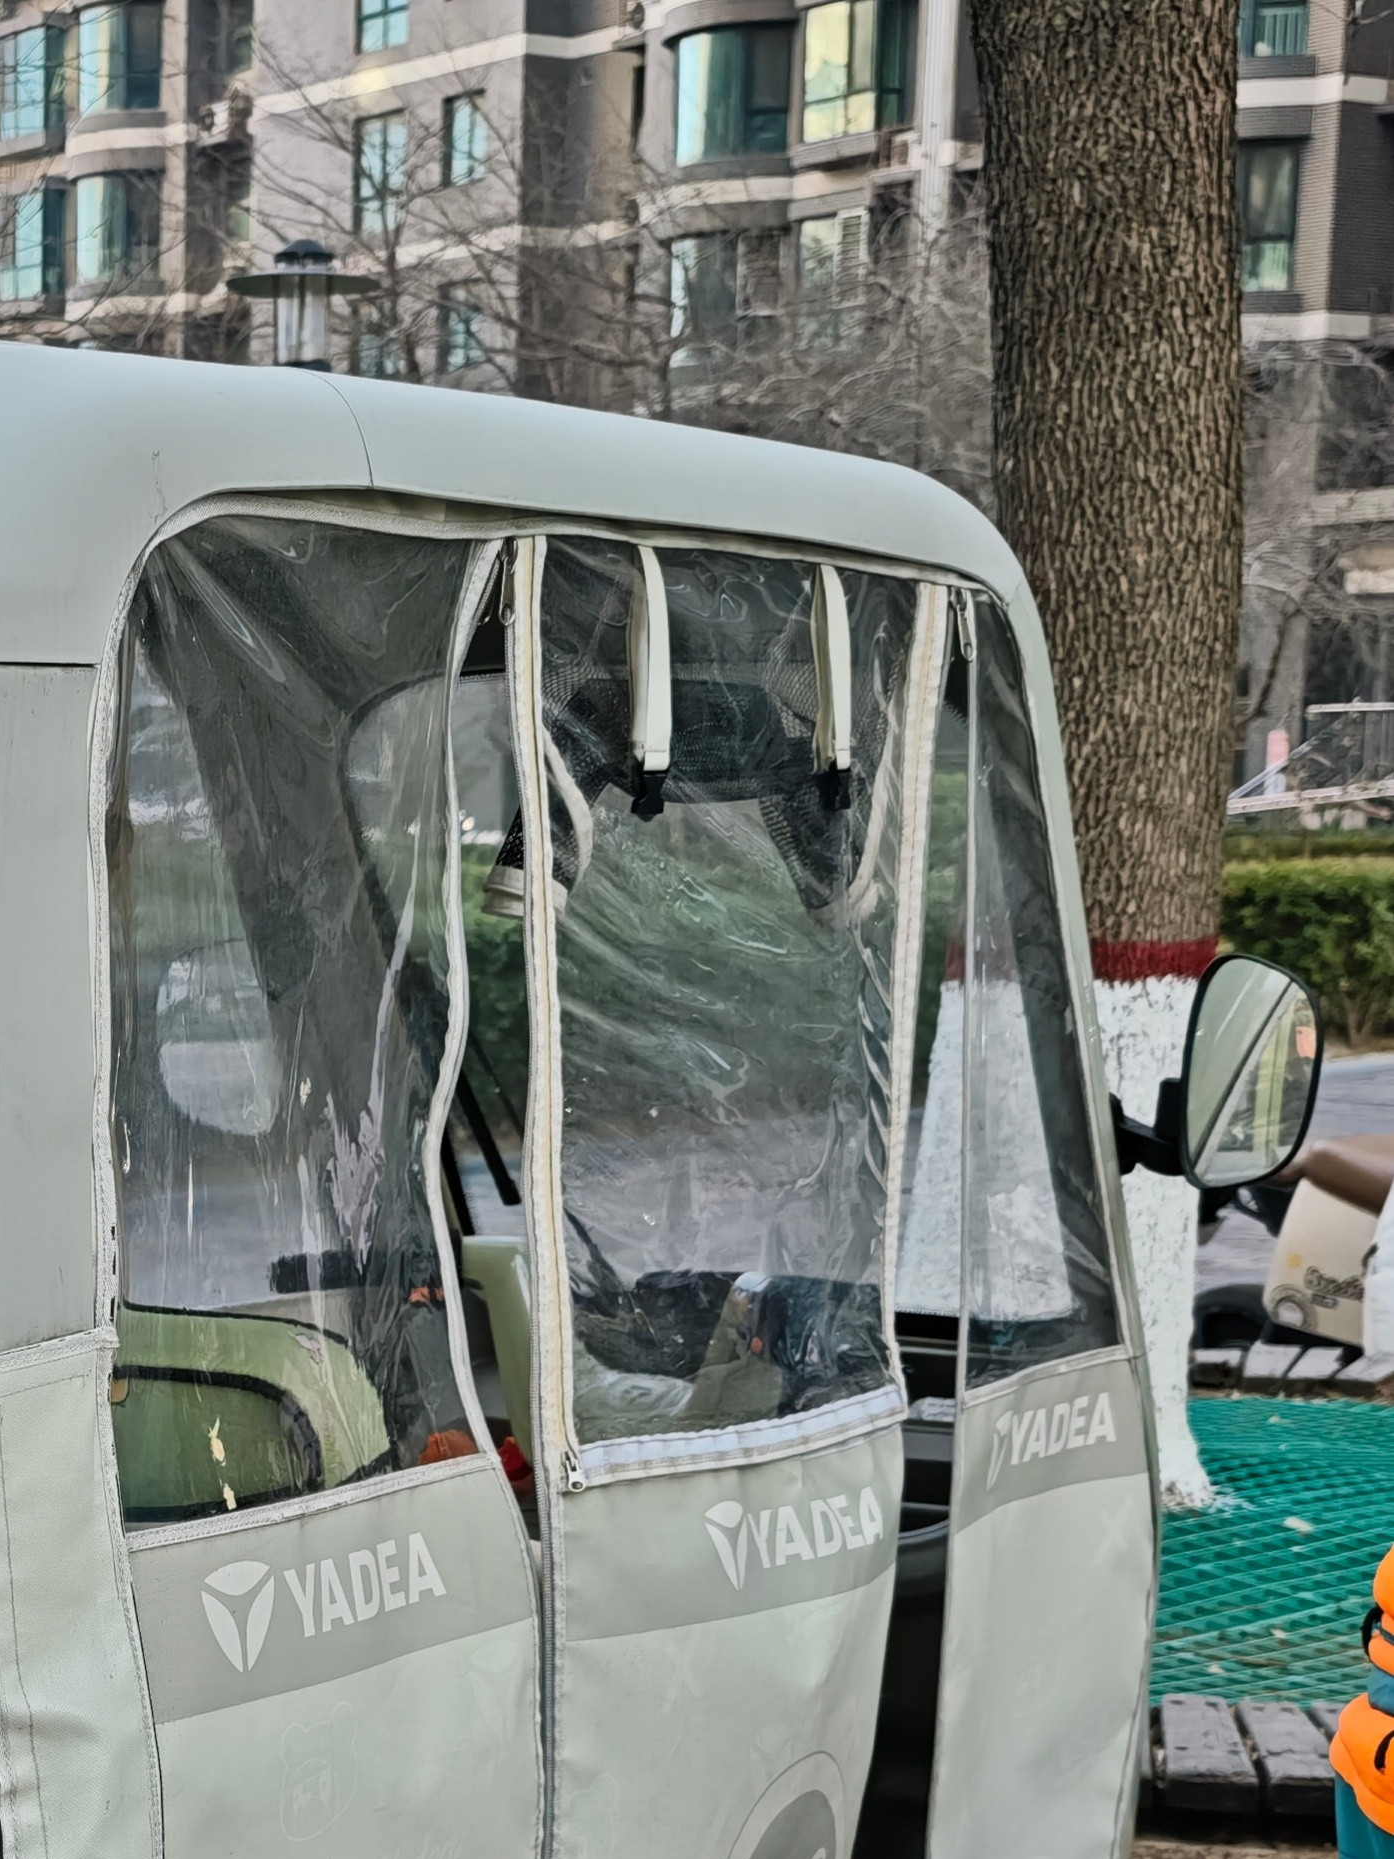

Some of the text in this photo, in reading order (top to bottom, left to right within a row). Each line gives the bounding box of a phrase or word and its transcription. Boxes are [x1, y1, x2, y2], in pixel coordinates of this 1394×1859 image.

[1009, 1391, 1117, 1466] YADEA
[746, 1486, 883, 1569] YADEA
[283, 1532, 448, 1638] YADEA
